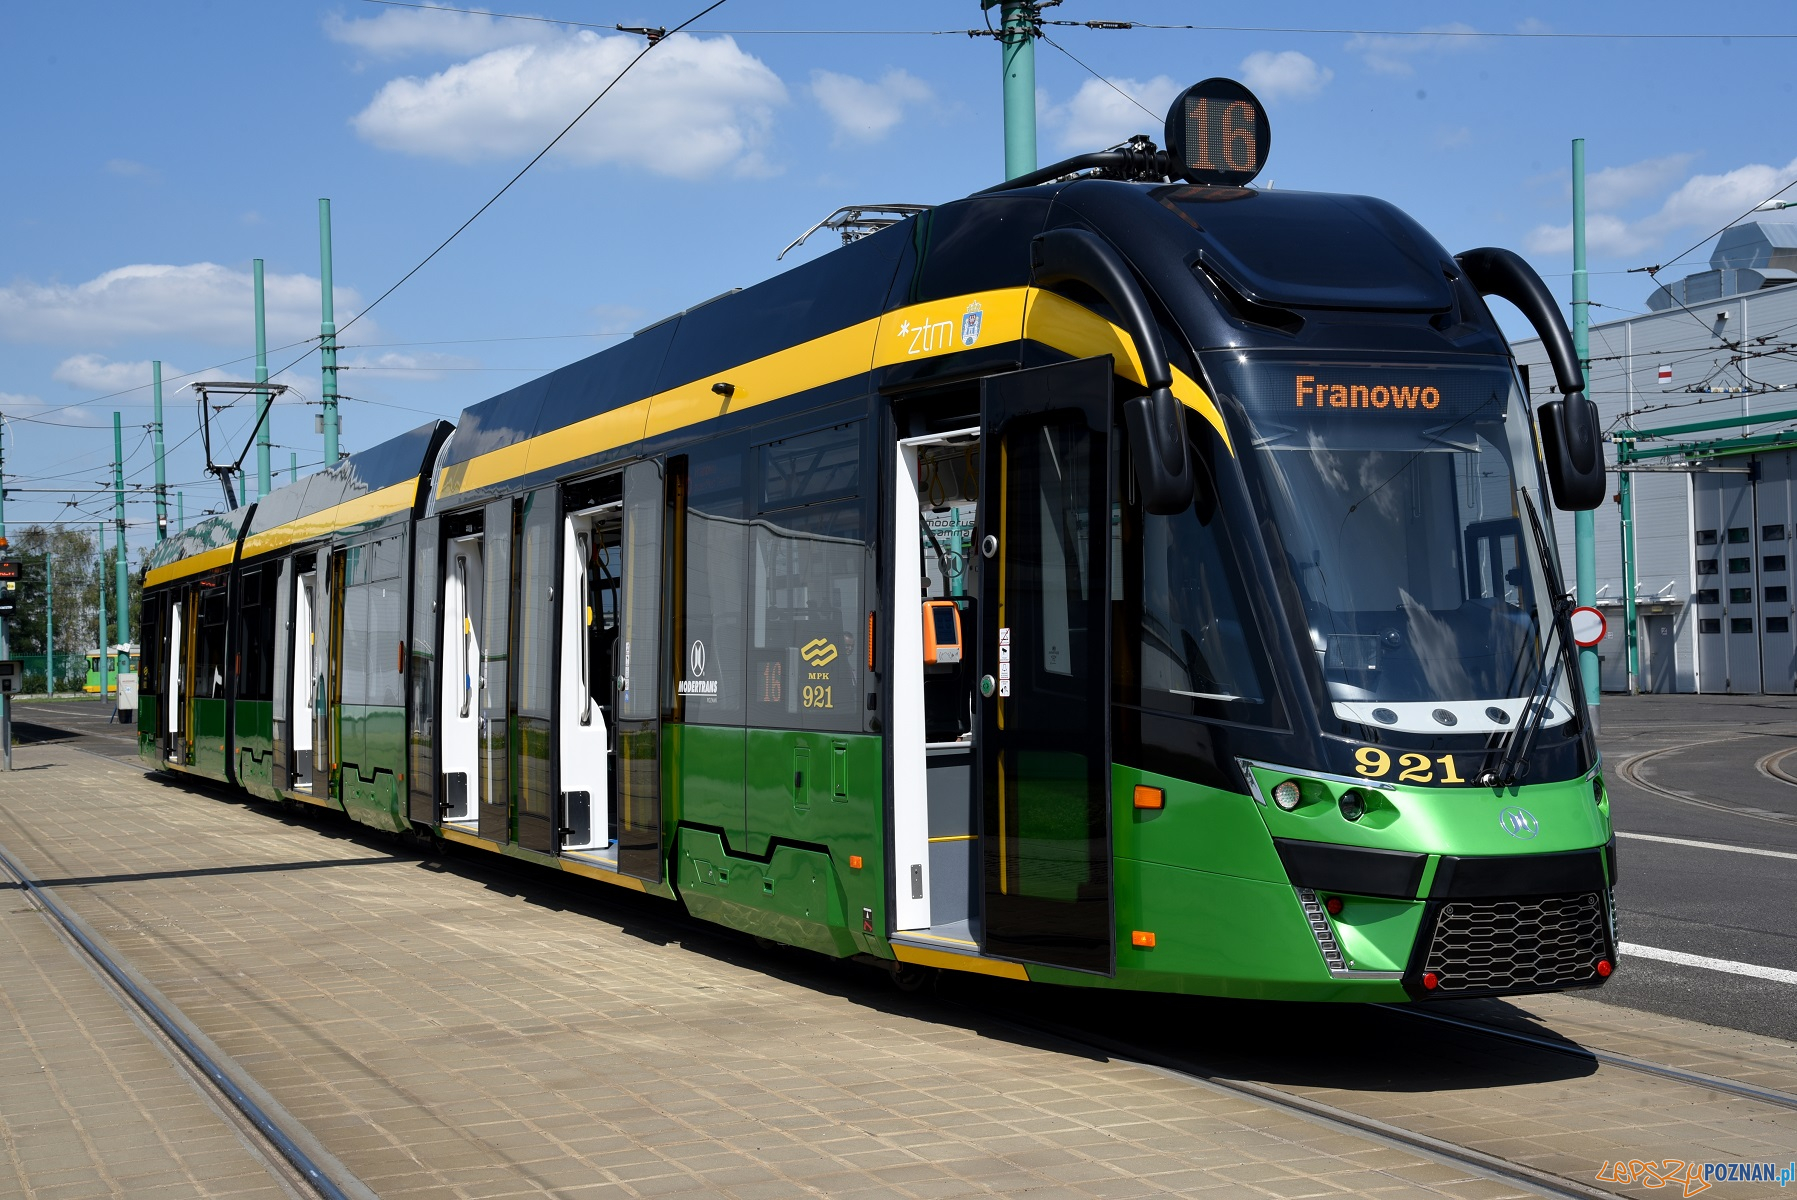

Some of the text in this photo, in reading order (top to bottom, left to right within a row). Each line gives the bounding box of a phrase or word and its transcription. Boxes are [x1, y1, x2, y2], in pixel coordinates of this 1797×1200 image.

[1189, 98, 1256, 172] 16
[1296, 375, 1440, 409] Franowo
[678, 680, 717, 693] MODERTRANS
[763, 661, 782, 702] 16
[803, 685, 834, 708] 921
[1354, 747, 1465, 783] 921
